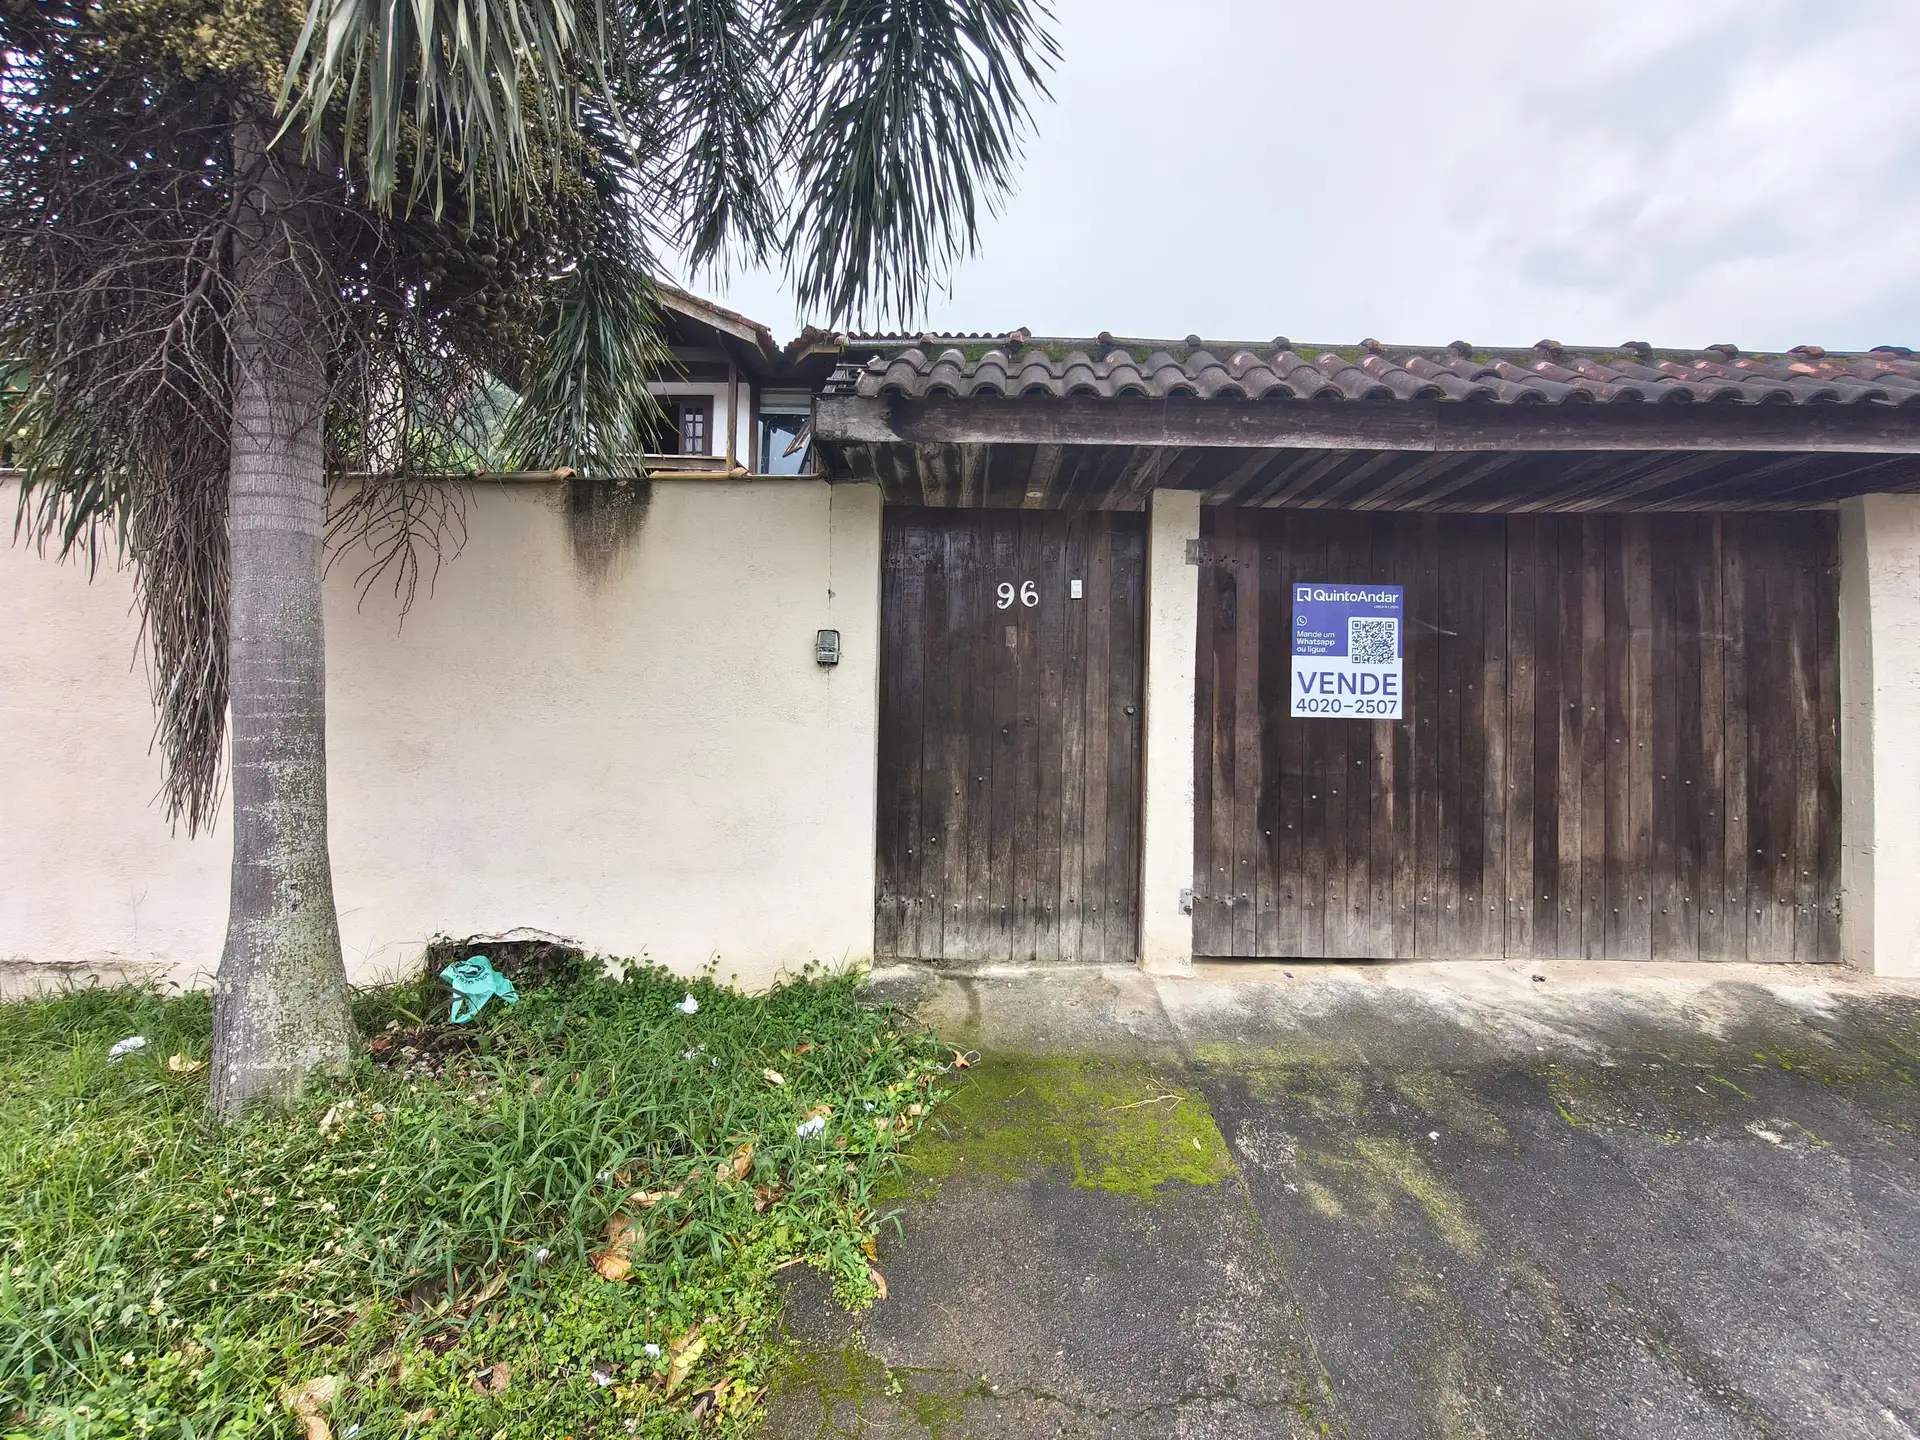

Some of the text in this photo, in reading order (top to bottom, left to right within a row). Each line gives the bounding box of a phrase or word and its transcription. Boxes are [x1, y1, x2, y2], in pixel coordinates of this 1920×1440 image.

[996, 580, 1039, 610] 96
[1313, 589, 1399, 603] QuintoAndar
[1296, 630, 1323, 638] Mande
[1296, 638, 1335, 647] Whatsapp
[1307, 646, 1328, 654] ligue.
[1297, 671, 1398, 696] VENDE
[1296, 698, 1398, 714] 4020-2507
